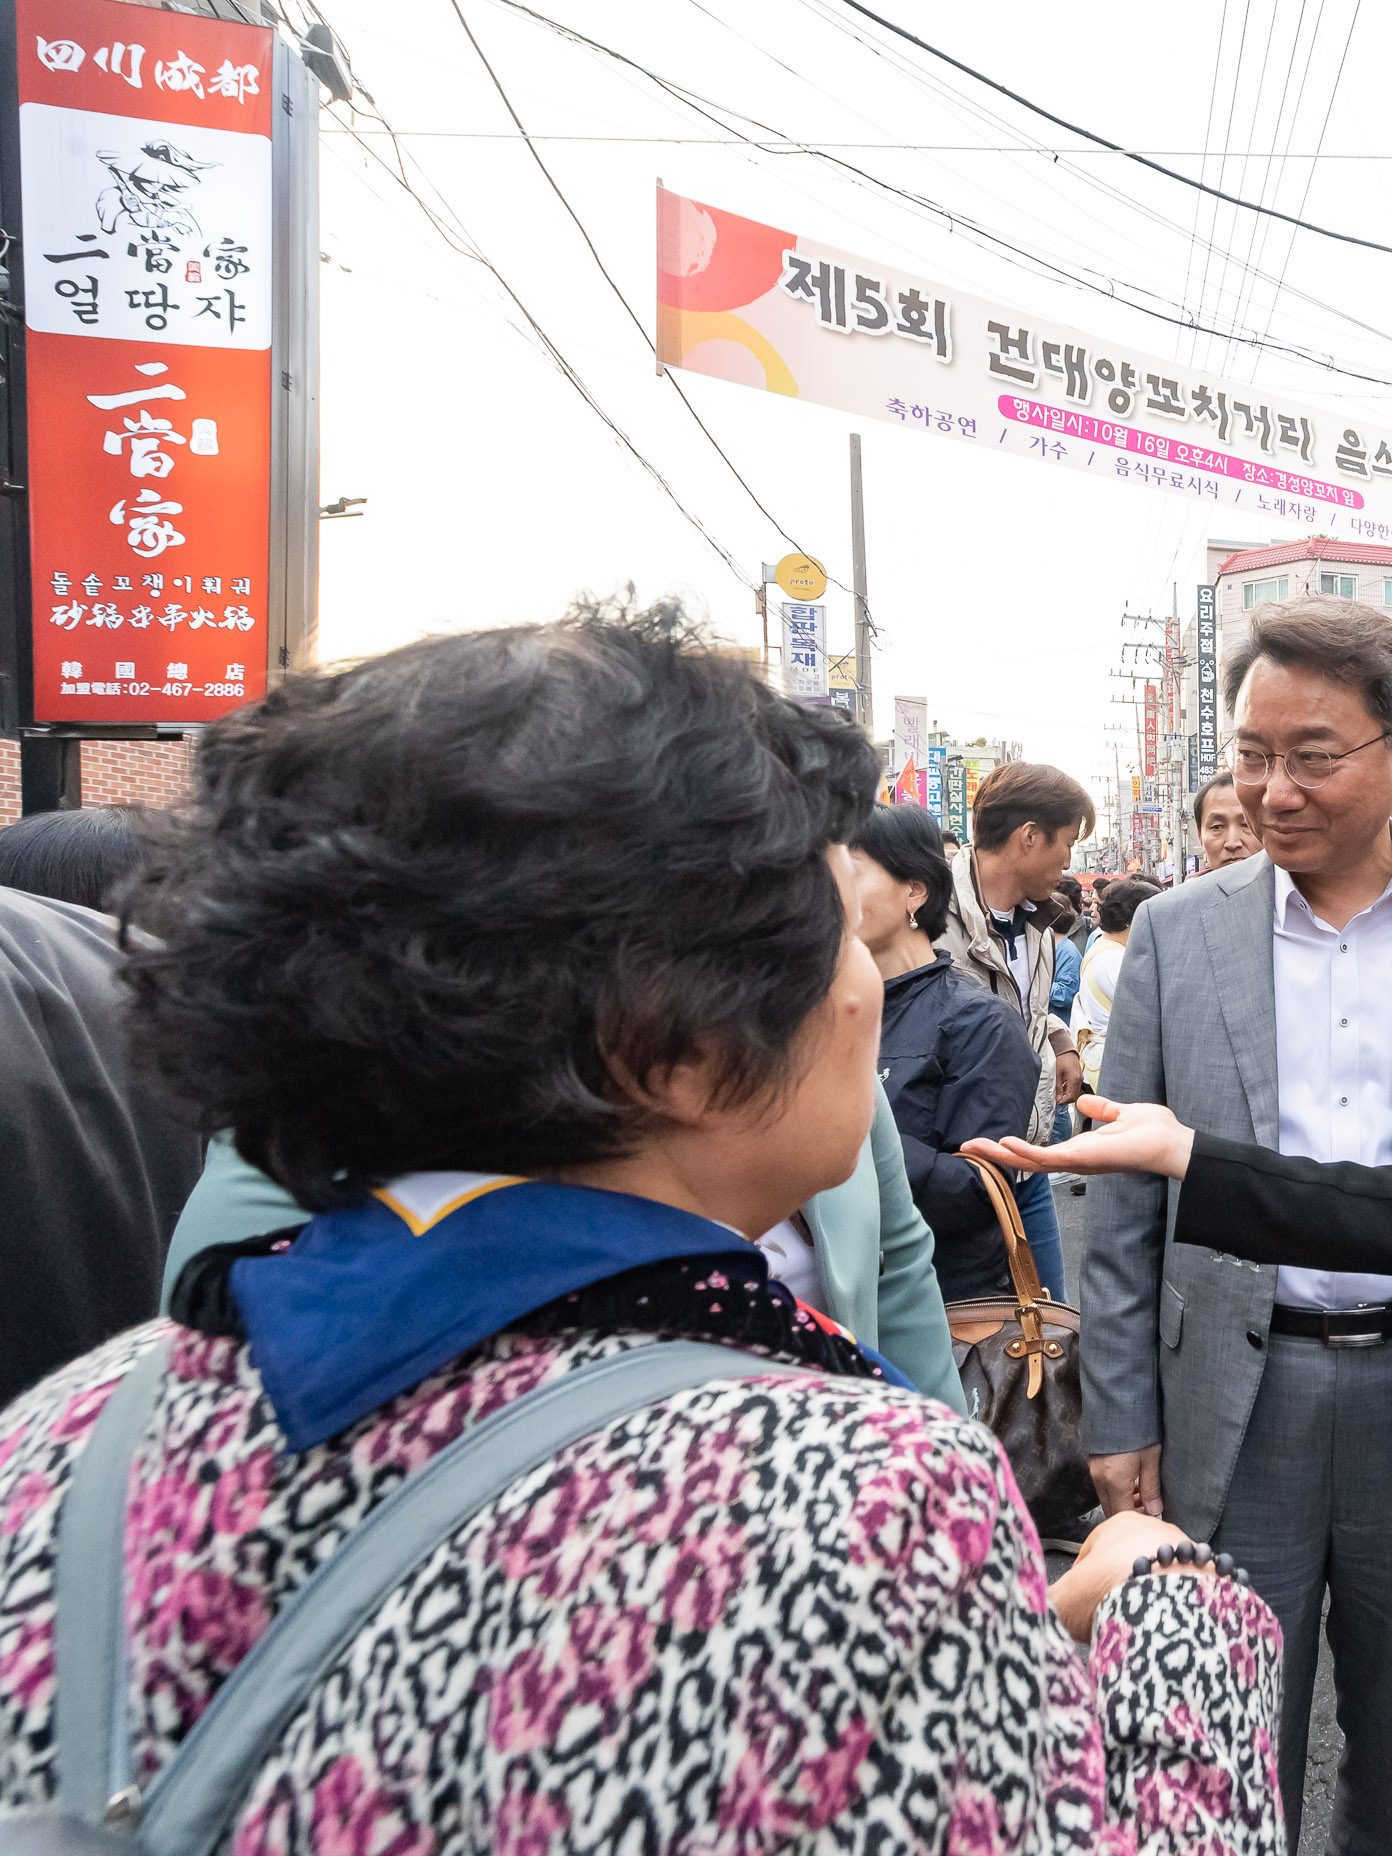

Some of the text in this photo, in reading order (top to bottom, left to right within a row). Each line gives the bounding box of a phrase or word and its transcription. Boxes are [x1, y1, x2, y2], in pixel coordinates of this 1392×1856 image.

[35, 34, 261, 105] 四川成都
[783, 254, 948, 359] 제5회
[986, 318, 1311, 463] 건대양꼬치거리
[885, 397, 977, 439] 축하공연
[1028, 435, 1069, 461] 가수
[1113, 456, 1220, 500] 음식무료시식
[1256, 493, 1318, 524] 노래자랑
[1012, 397, 1356, 508] 행사일시:10월 16일 오후4시 장소:경성양꼬치 앞
[49, 571, 252, 598] 돌솥꼬챙이훠궈
[789, 578, 815, 586] proto
[1199, 587, 1216, 655] 요리주점
[60, 661, 246, 682] 韓國總店
[1200, 688, 1216, 754] 천수호프
[1200, 753, 1216, 763] HOF
